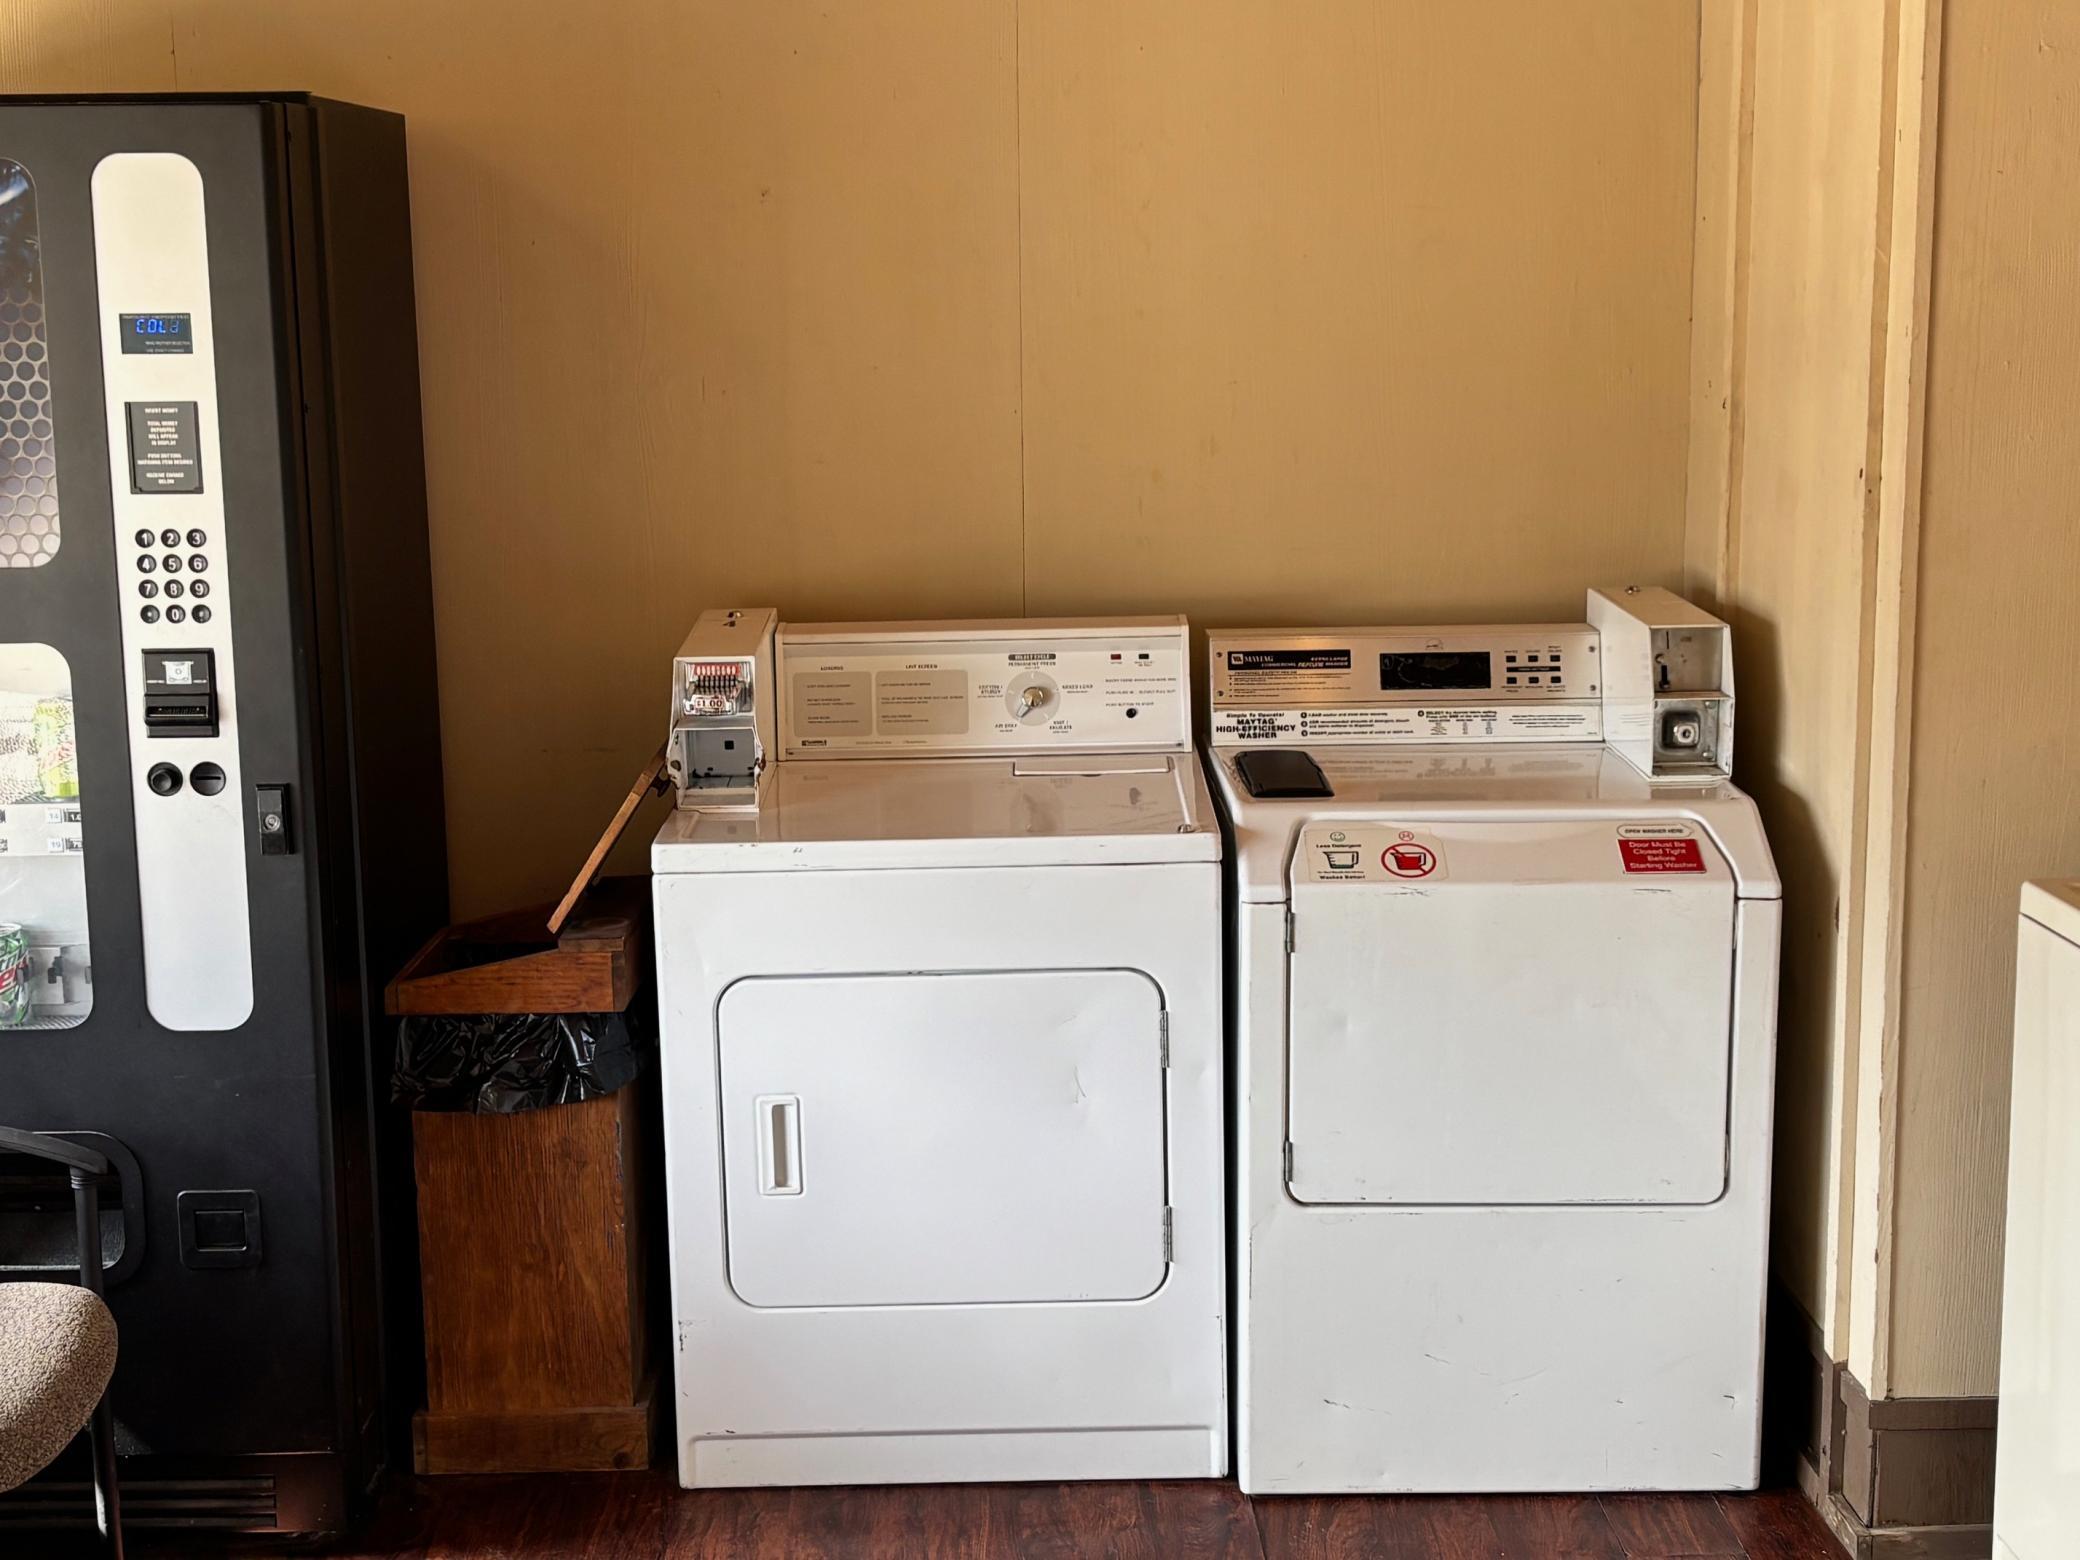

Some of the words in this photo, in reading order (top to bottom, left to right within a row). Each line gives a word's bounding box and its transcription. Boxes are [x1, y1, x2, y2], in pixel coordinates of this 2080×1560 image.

[141, 533, 148, 546] 1
[166, 533, 174, 545] 2
[192, 533, 200, 545] 3
[142, 558, 150, 570] 4
[168, 558, 176, 571] 5
[193, 558, 202, 570] 6
[144, 584, 151, 596] 7
[170, 583, 178, 596] 8
[195, 583, 203, 596] 9
[171, 608, 179, 621] 0
[1244, 655, 1274, 663] MAYTAG
[1215, 724, 1296, 733] HIGH-EFFICIENCY
[1238, 732, 1277, 740] WASHER
[1665, 848, 1686, 856] Tight
[1630, 862, 1663, 870] Starting
